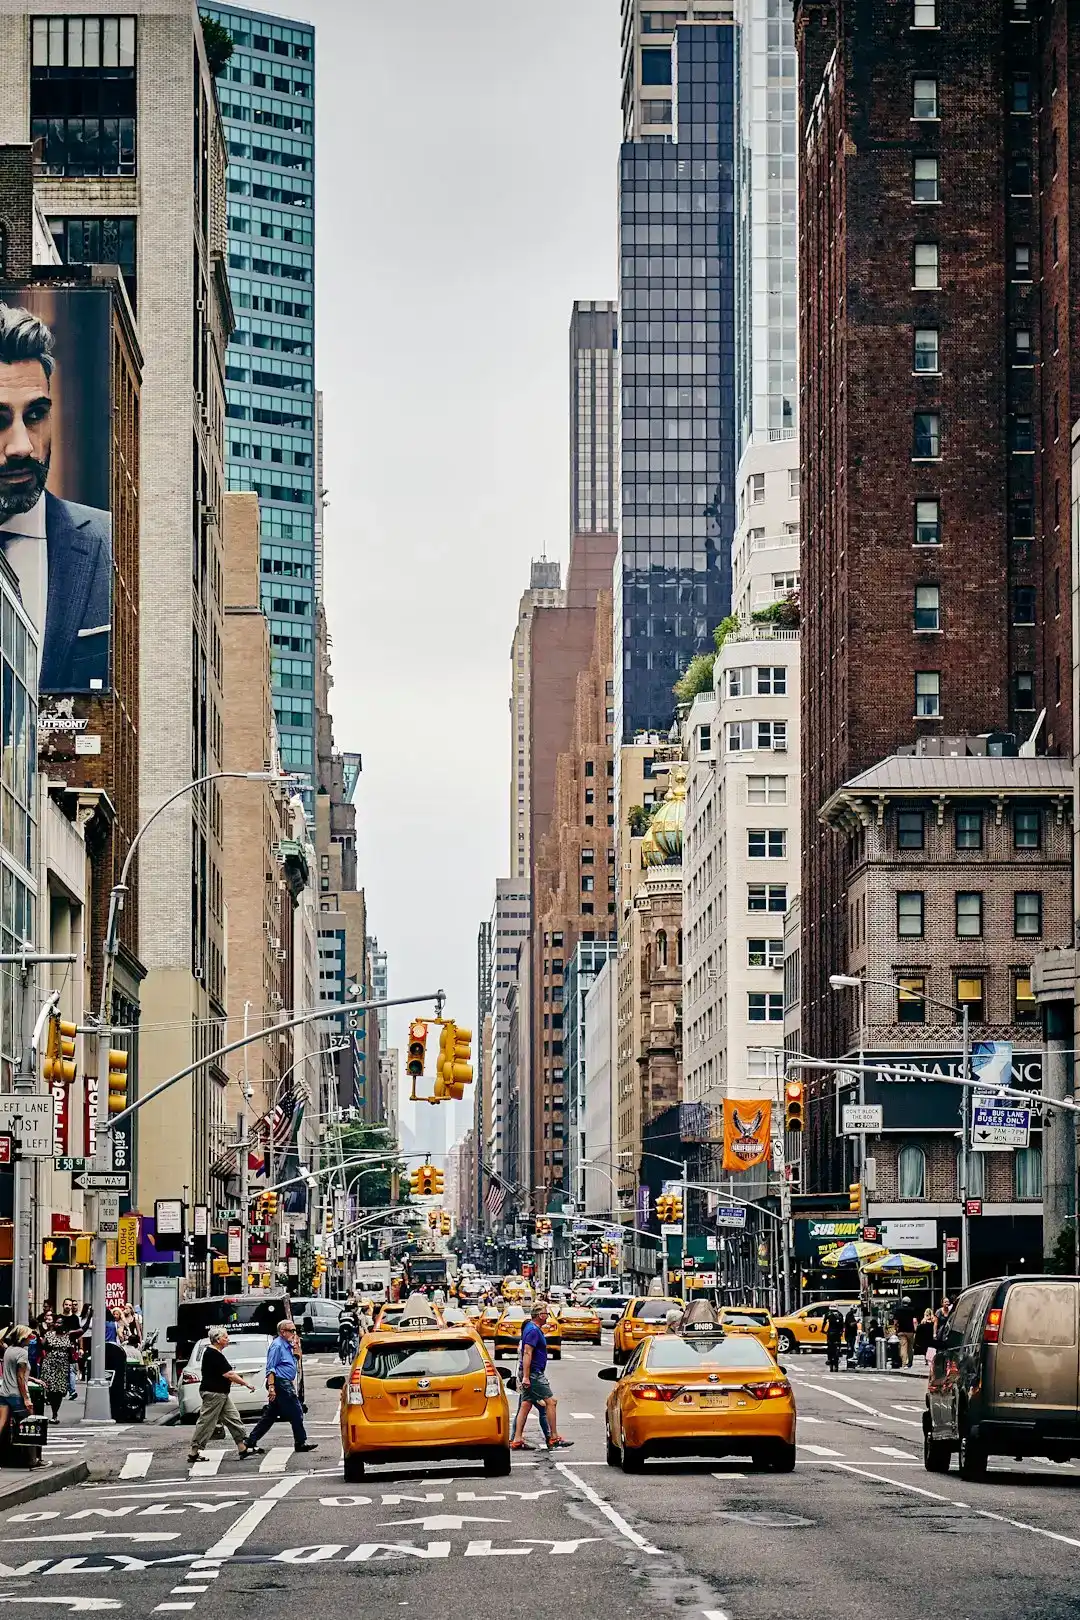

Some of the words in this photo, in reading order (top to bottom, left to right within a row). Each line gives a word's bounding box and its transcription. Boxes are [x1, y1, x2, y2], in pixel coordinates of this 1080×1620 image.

[25, 1103, 49, 1113] LANE
[992, 1109, 1005, 1117] BUS
[1006, 1110, 1024, 1118] LANE
[977, 1115, 1003, 1123] BUSES
[1005, 1117, 1026, 1125] ONLY
[26, 1139, 48, 1149] LEFT
[56, 1159, 61, 1170] E
[63, 1158, 74, 1170] 58
[76, 1158, 84, 1166] ST
[80, 1177, 97, 1185] ONE
[104, 1176, 123, 1185] WAY
[810, 1222, 861, 1236] SUBWAY
[119, 1228, 128, 1256] PHOTO
[127, 1221, 136, 1262] PASSPORT
[106, 1283, 124, 1291] 00%
[106, 1291, 125, 1299] EMY
[694, 1322, 714, 1331] 9N89
[318, 1489, 559, 1507] ONLY
[6, 1500, 244, 1522] ONLY
[268, 1537, 603, 1563] ONLY
[0, 1553, 205, 1577] NLY
